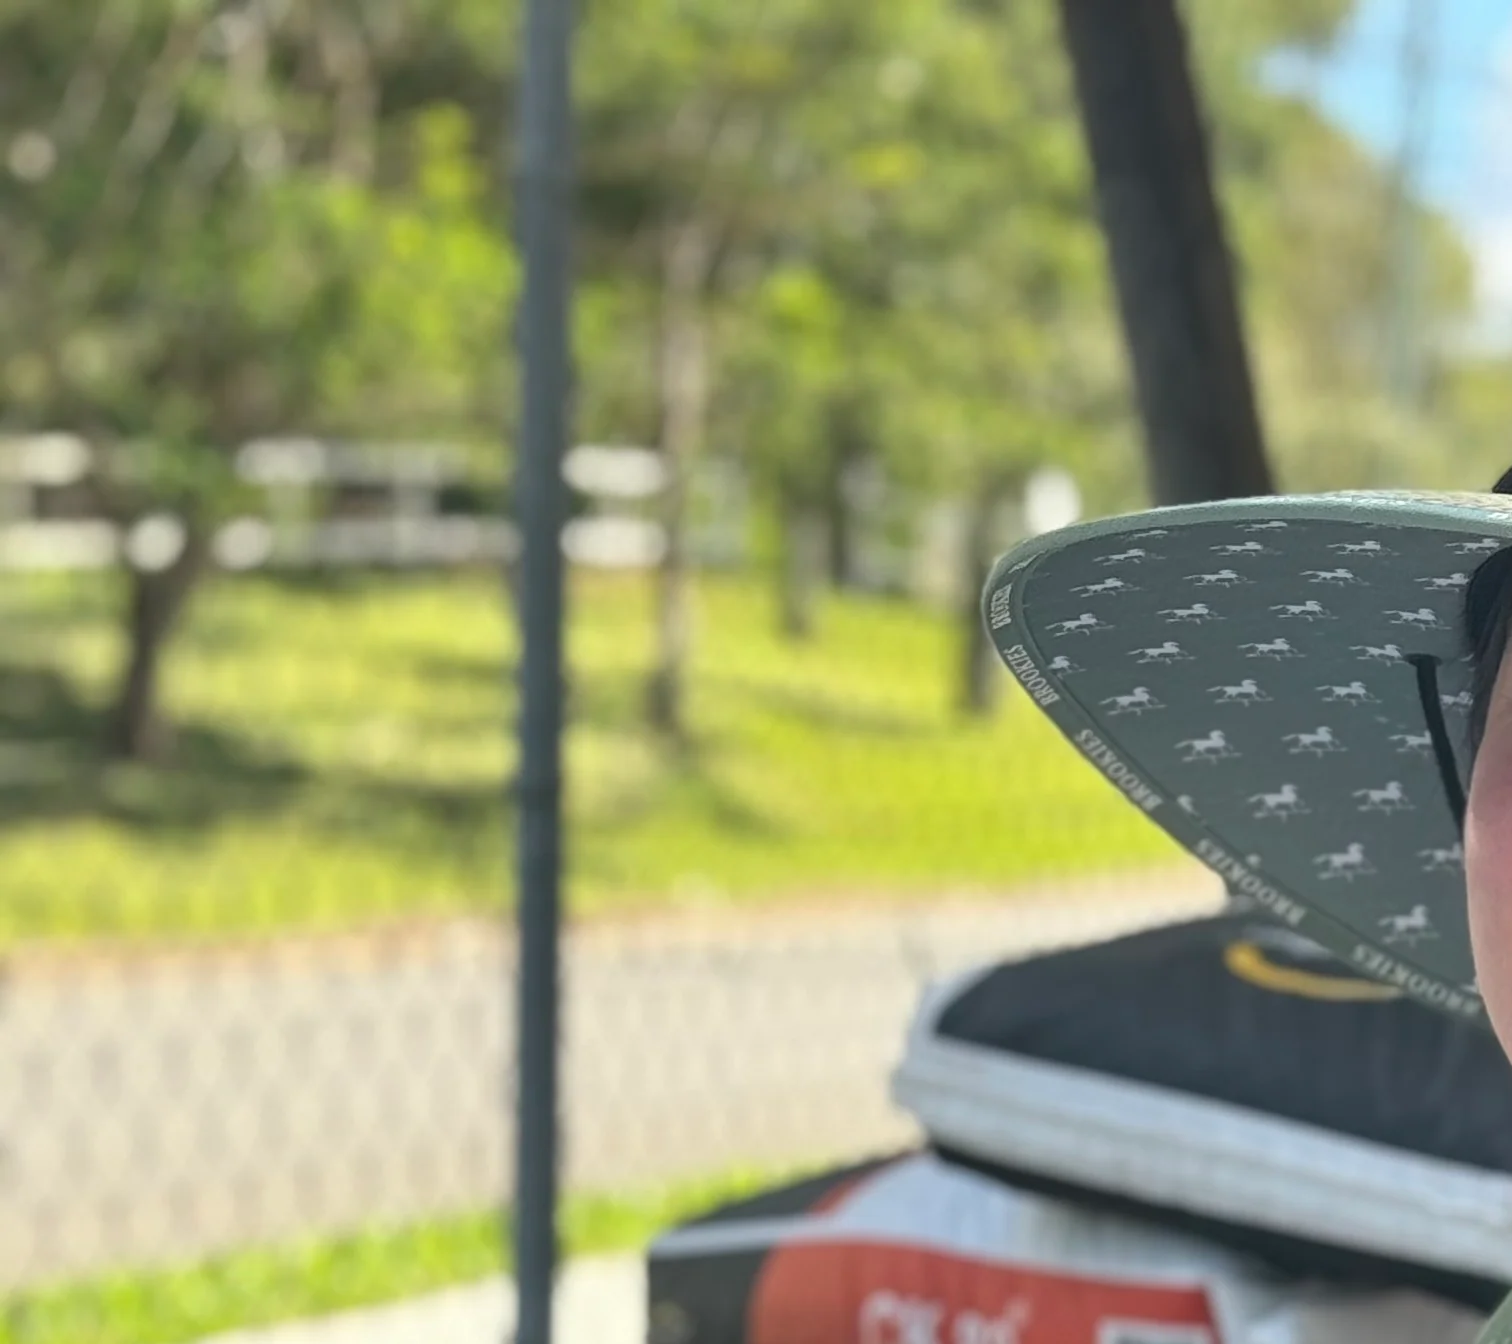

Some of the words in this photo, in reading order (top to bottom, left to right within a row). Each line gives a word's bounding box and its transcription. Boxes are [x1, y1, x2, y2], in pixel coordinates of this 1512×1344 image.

[1003, 643, 1060, 707] BROOKIES
[1073, 728, 1164, 811] BROOKIES
[1196, 837, 1309, 926] BROOKIES
[1352, 942, 1484, 1016] BROOKIES
